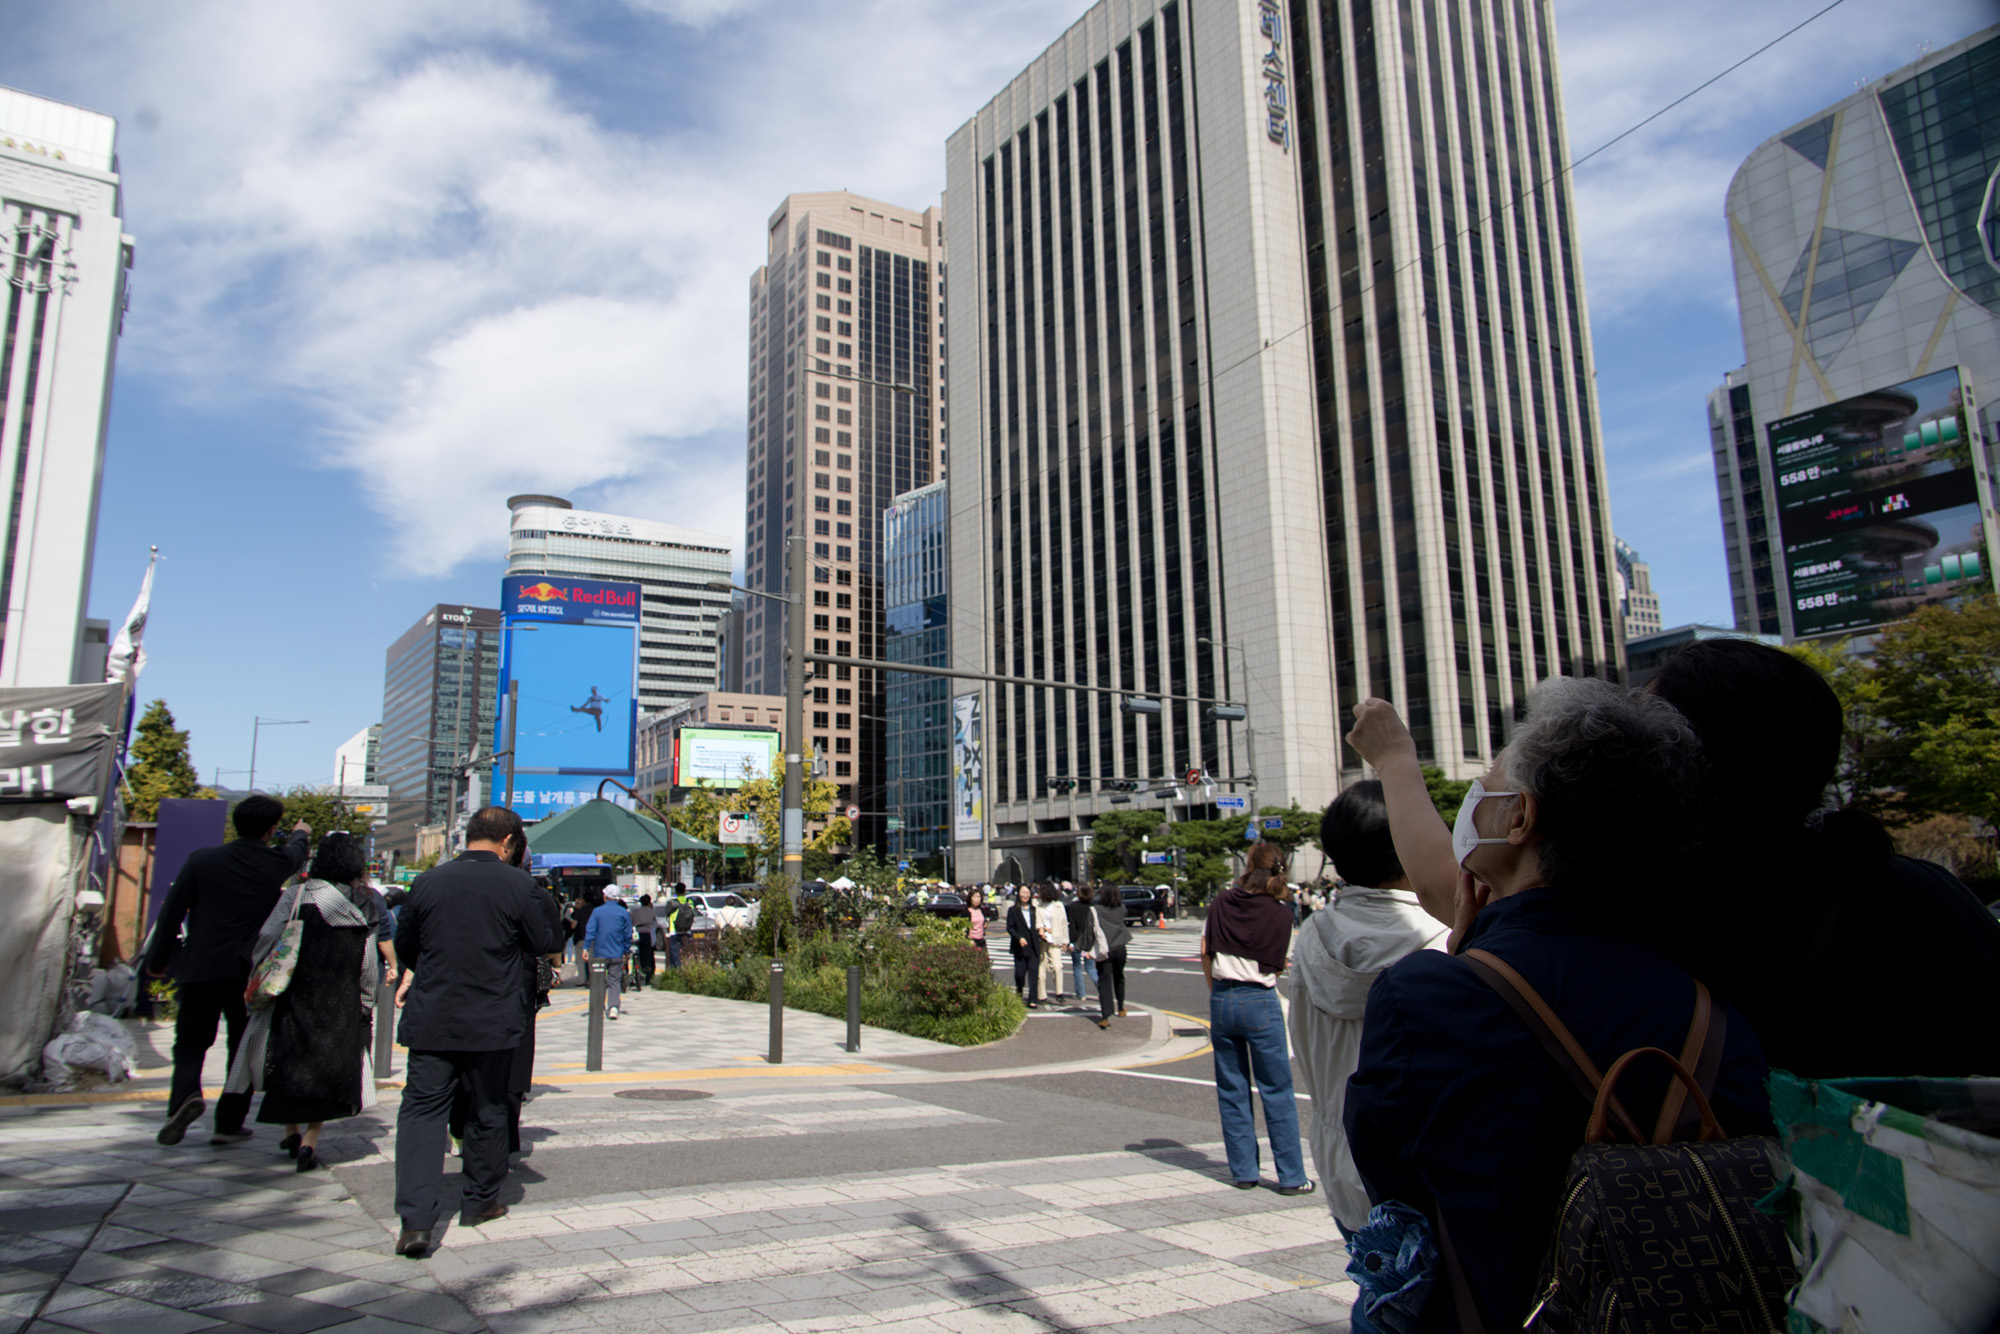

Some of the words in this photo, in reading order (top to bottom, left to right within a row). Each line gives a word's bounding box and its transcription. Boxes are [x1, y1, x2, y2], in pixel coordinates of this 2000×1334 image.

[1258, 0, 1289, 154] 레스센터
[1780, 465, 1821, 486] 558만
[572, 588, 604, 605] Red
[606, 590, 636, 606] Bull
[1797, 591, 1838, 610] 558만
[971, 694, 982, 791] NEXT
[963, 745, 973, 815] ART
